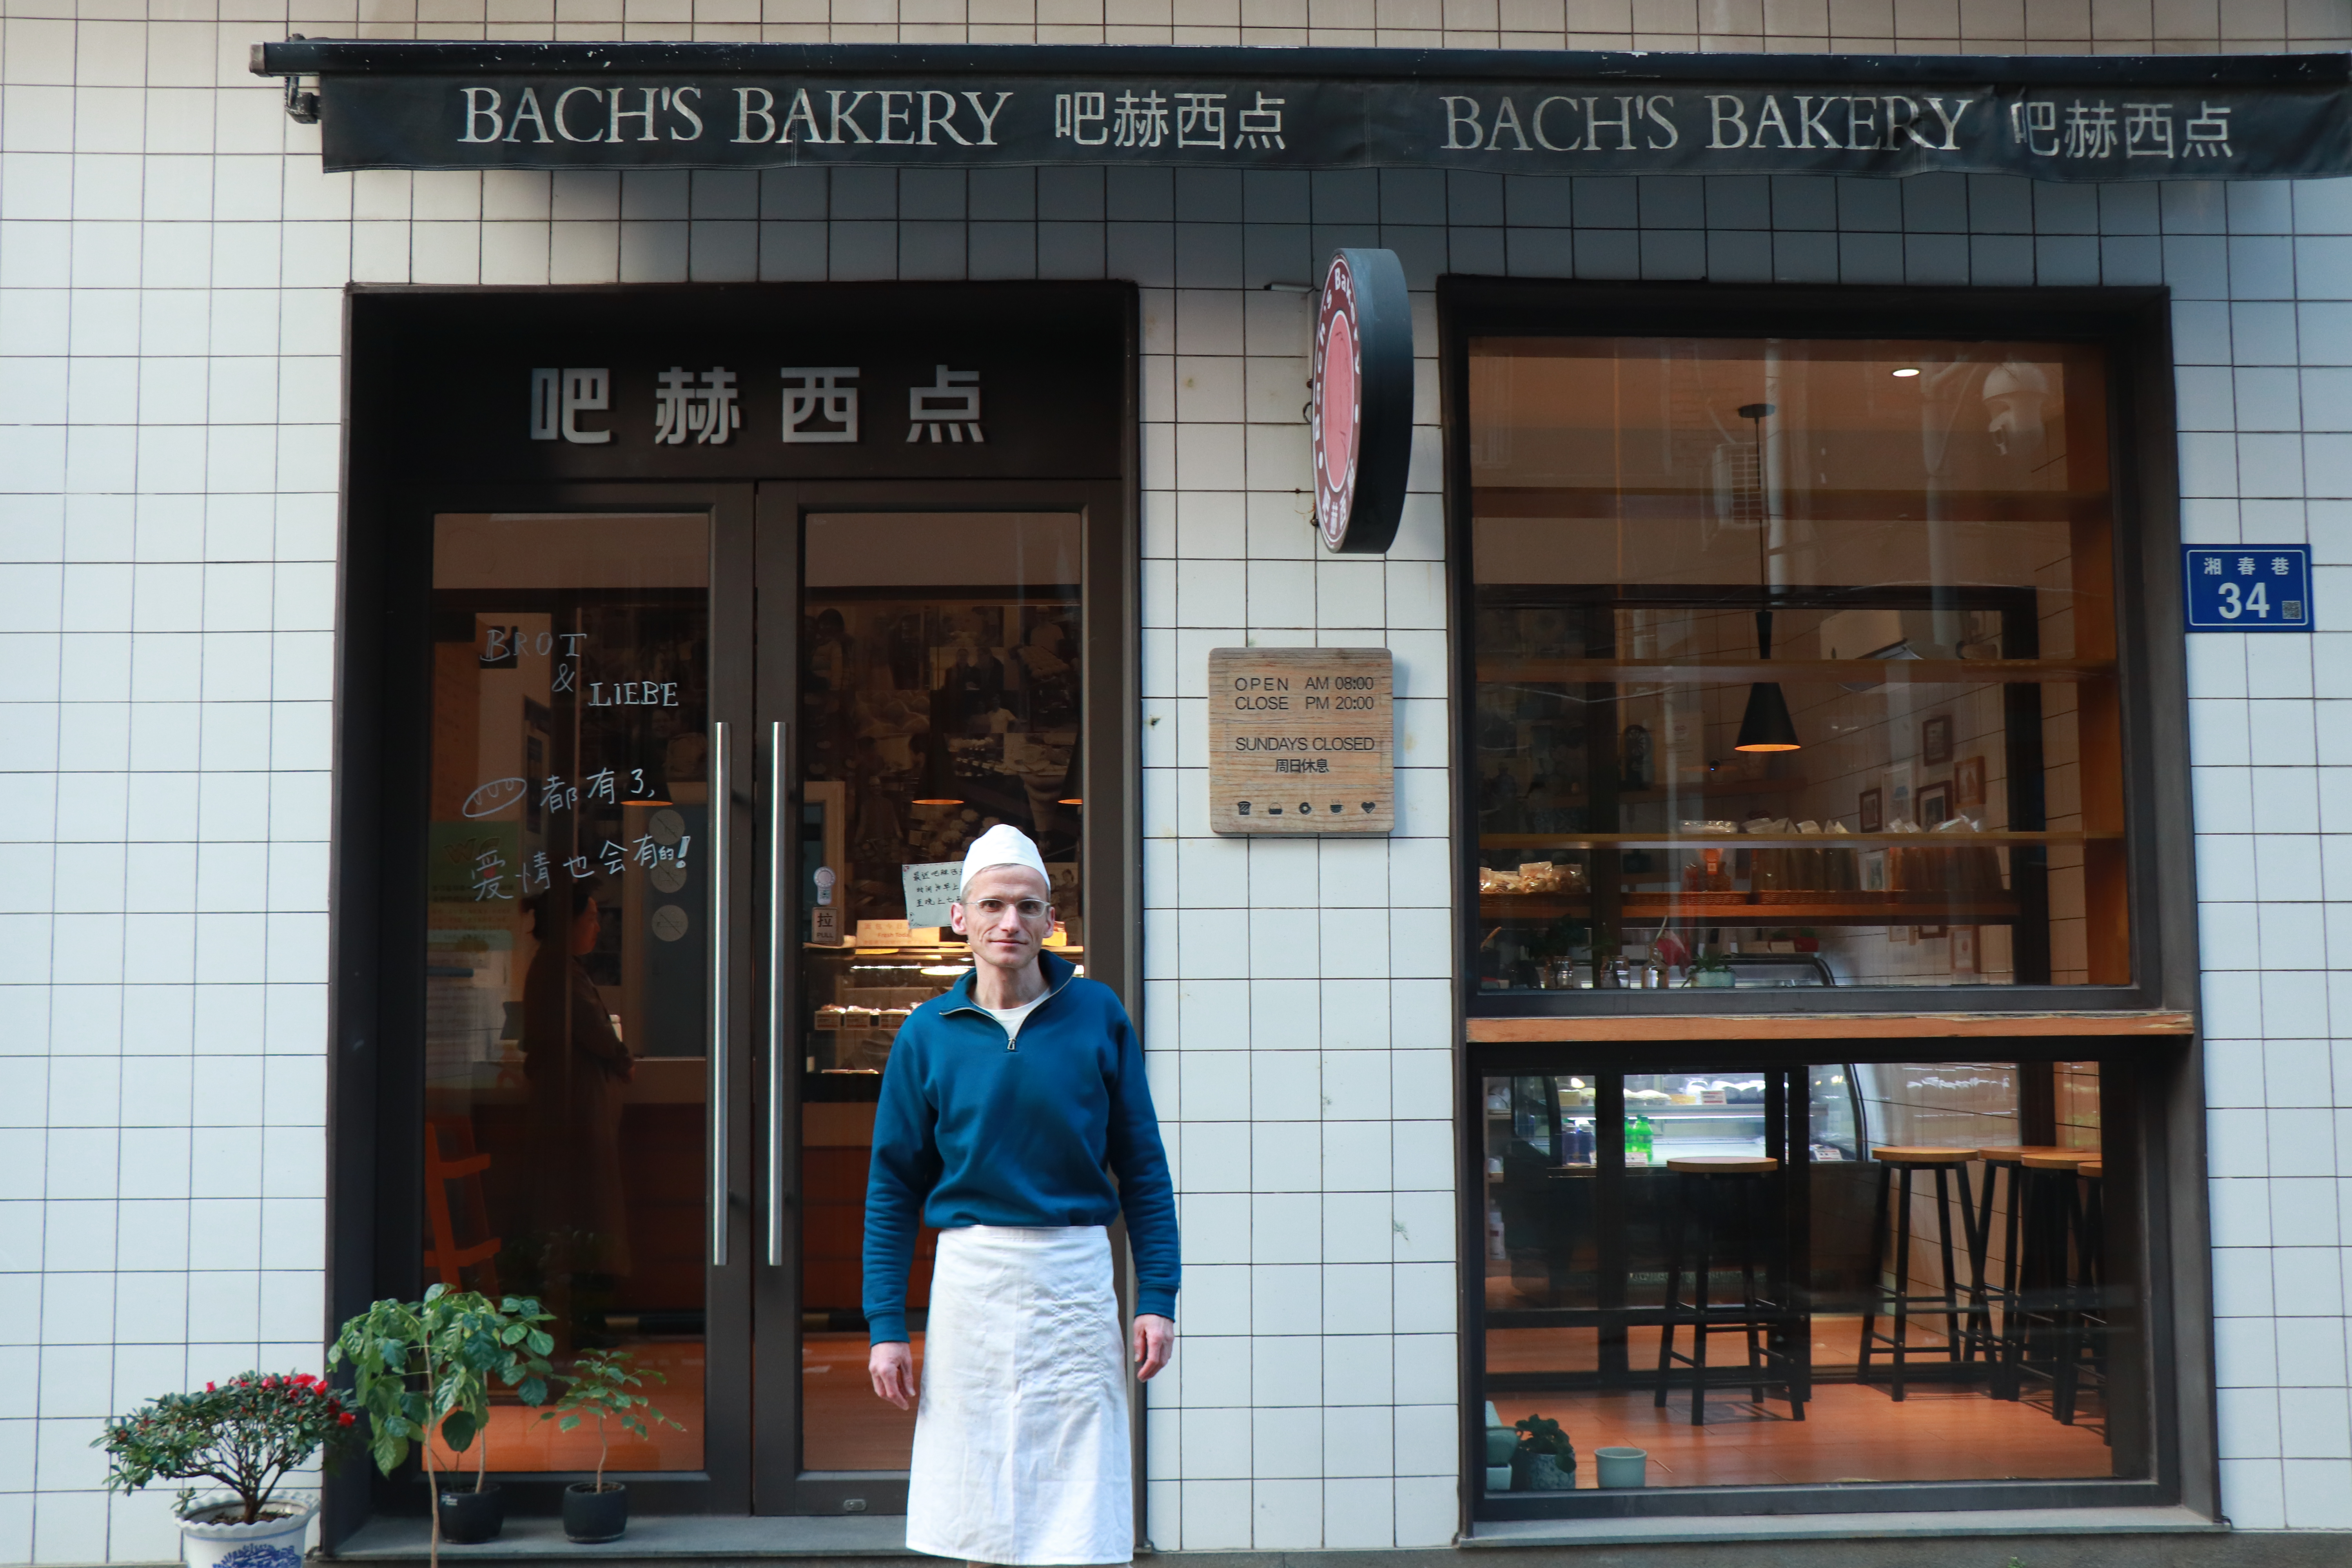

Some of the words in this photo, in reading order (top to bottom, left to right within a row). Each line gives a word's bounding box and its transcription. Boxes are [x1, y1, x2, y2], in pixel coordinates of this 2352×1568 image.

[457, 86, 703, 143] BACH'S
[730, 87, 1014, 145] BAKERY
[1055, 90, 1285, 150] 吧赫西点
[1439, 95, 1679, 151] BACH'S
[1704, 94, 1974, 151] BAKERY
[2011, 99, 2233, 159] 吧赫西点
[531, 365, 984, 444] 吧赫西点
[2203, 557, 2289, 575] 湘春巷
[2218, 582, 2270, 619] 34
[480, 630, 587, 661] BROT
[552, 663, 575, 692] &
[1235, 677, 1289, 691] OPEN
[1305, 677, 1329, 690] AM
[1335, 676, 1374, 690] 08:00
[1235, 696, 1289, 710] CLOSE
[1306, 696, 1329, 710] PM
[1335, 696, 1374, 710] 20:00
[1236, 737, 1308, 751] SUNDAYS
[1312, 737, 1375, 751] CLOSED
[1275, 758, 1329, 773] 周日休息
[817, 913, 833, 927] 拉
